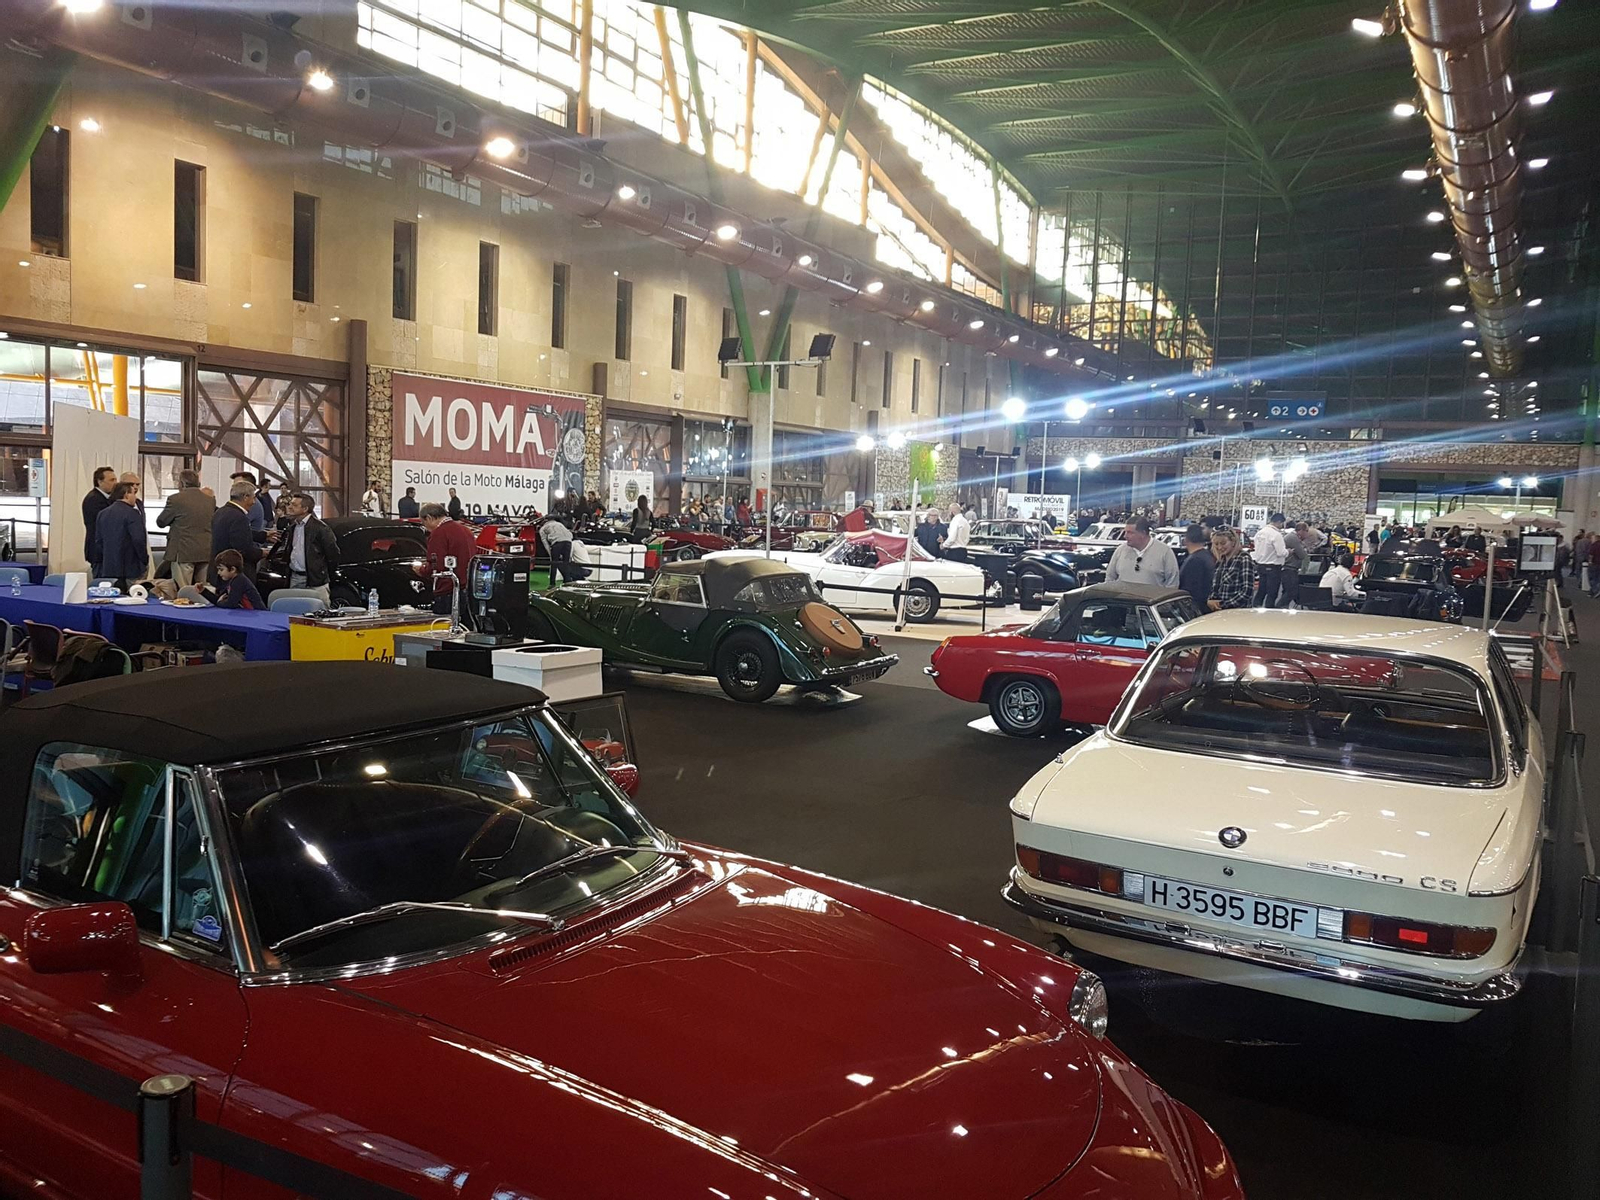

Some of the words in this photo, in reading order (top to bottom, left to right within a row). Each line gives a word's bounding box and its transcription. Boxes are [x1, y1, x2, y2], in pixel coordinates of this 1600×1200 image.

[1282, 406, 1289, 416] 2
[405, 393, 545, 455] MOMA
[405, 469, 440, 485] Salón
[443, 471, 458, 486] de
[460, 471, 471, 487] la
[474, 473, 502, 488] Moto
[505, 475, 545, 493] Málaga
[1244, 509, 1255, 520] 60
[1420, 876, 1457, 893] CS
[1253, 900, 1309, 932] BBF
